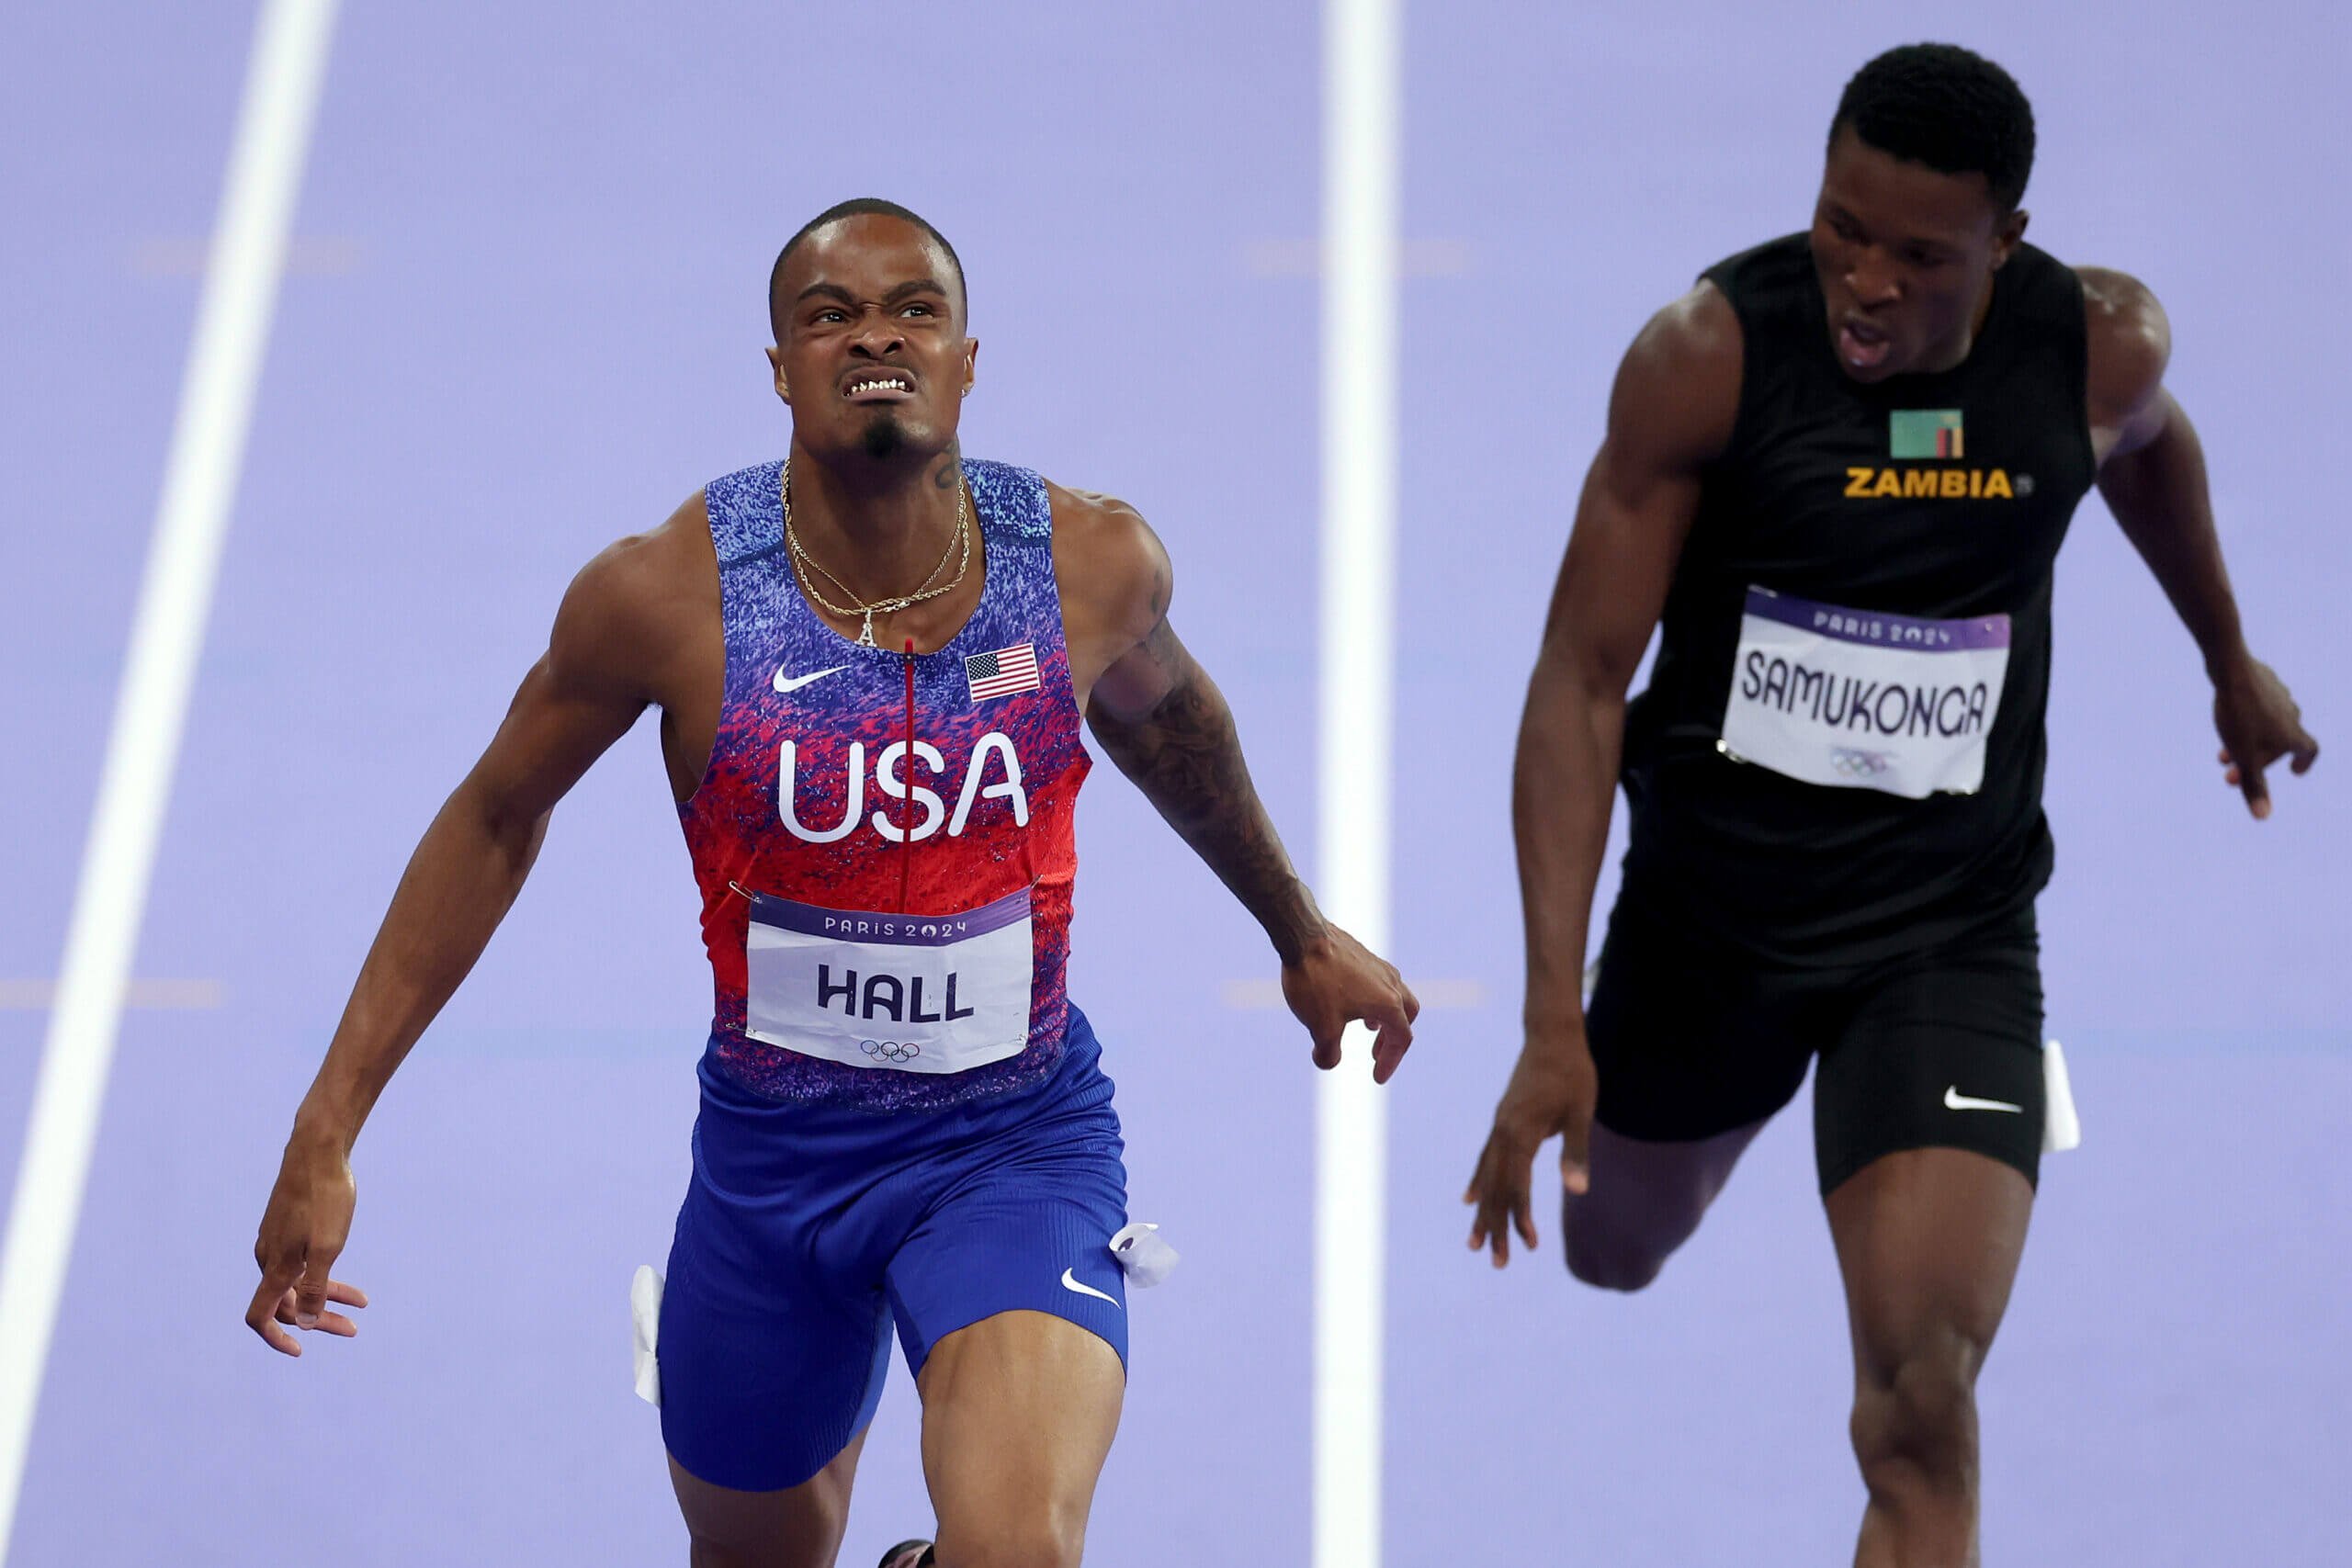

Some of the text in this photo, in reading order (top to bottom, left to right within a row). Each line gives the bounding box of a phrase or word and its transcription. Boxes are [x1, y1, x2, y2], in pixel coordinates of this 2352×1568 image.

[1844, 467, 2014, 499] ZAMBIA
[1890, 624, 1951, 645] 2024
[1743, 649, 1987, 738] SAMUKONGA
[778, 731, 1029, 844] USA
[905, 921, 966, 937] 2024
[818, 963, 974, 1023] HALL
